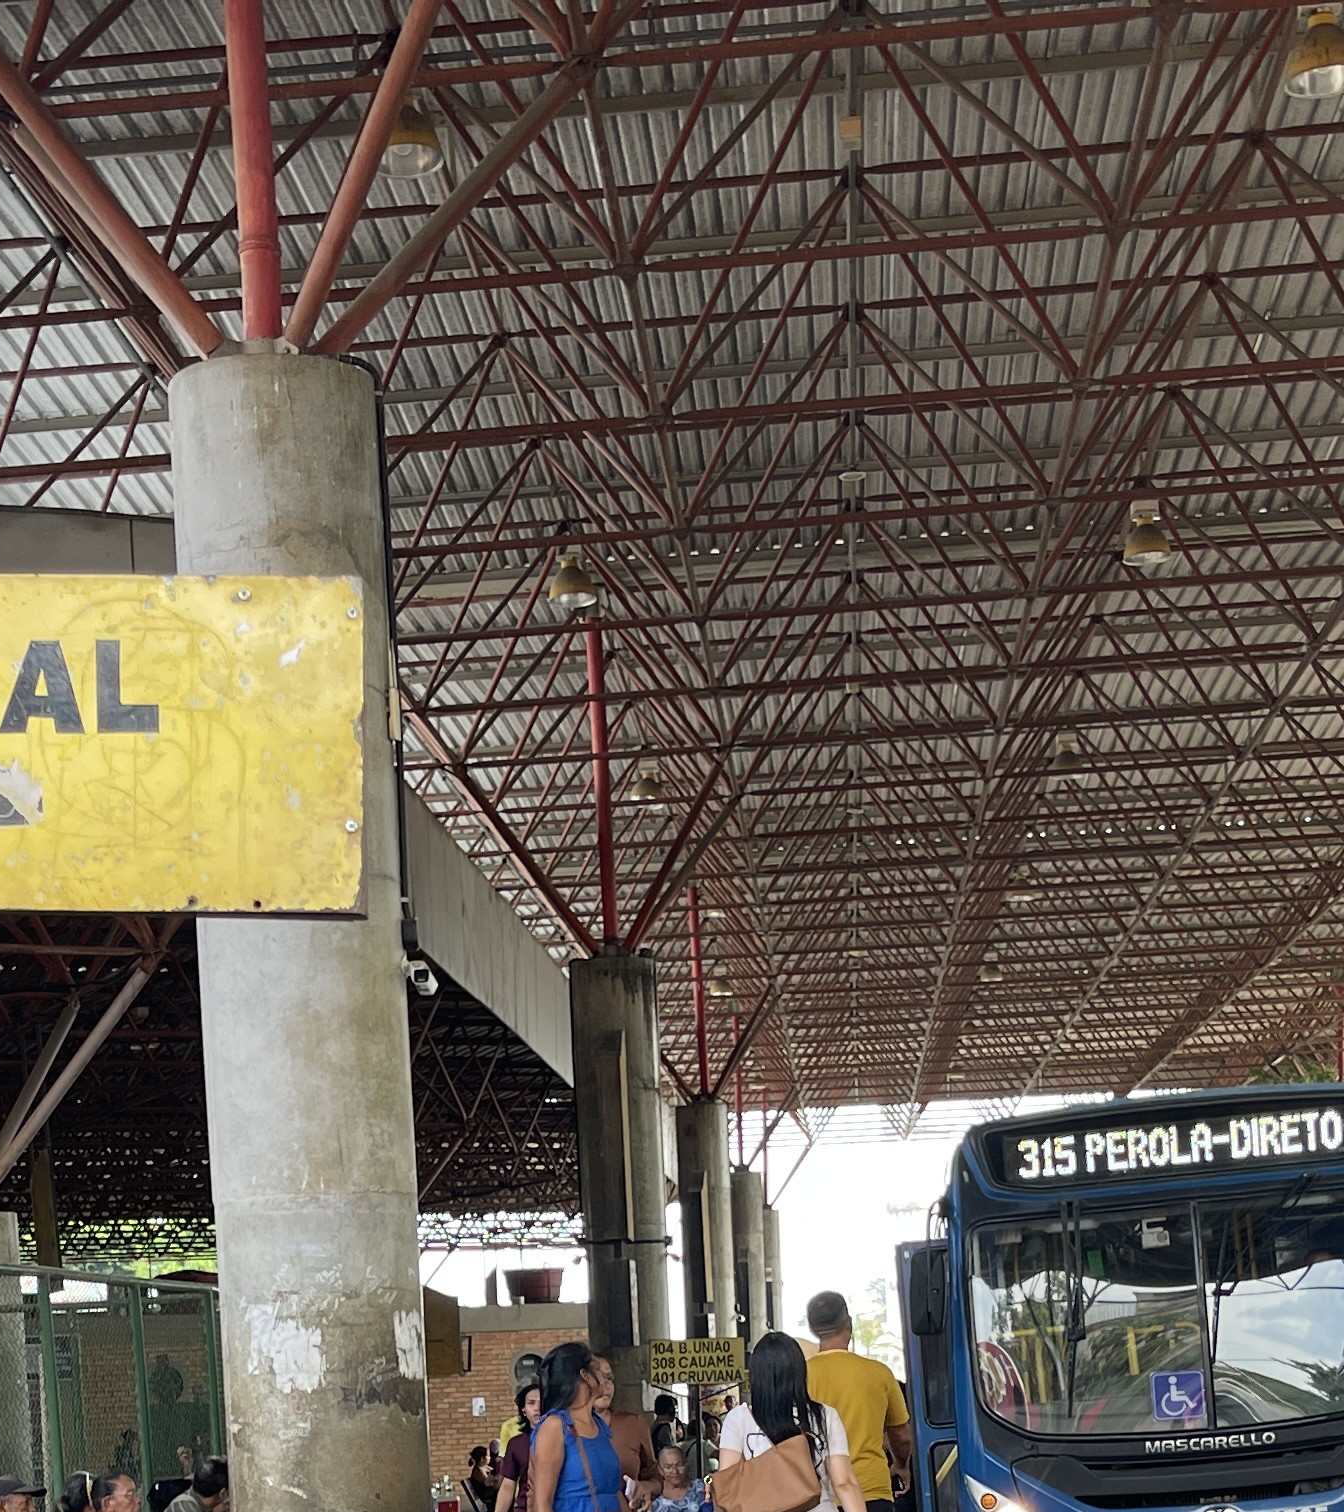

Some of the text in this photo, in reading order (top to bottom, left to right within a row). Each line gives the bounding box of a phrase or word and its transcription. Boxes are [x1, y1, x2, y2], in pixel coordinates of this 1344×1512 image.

[1017, 1134, 1077, 1179] 315
[651, 1342, 674, 1355] 104
[652, 1357, 675, 1369] 308
[652, 1371, 675, 1384] 401
[678, 1369, 743, 1383] CRUVIANA
[1145, 1432, 1276, 1454] MASCARELLO
